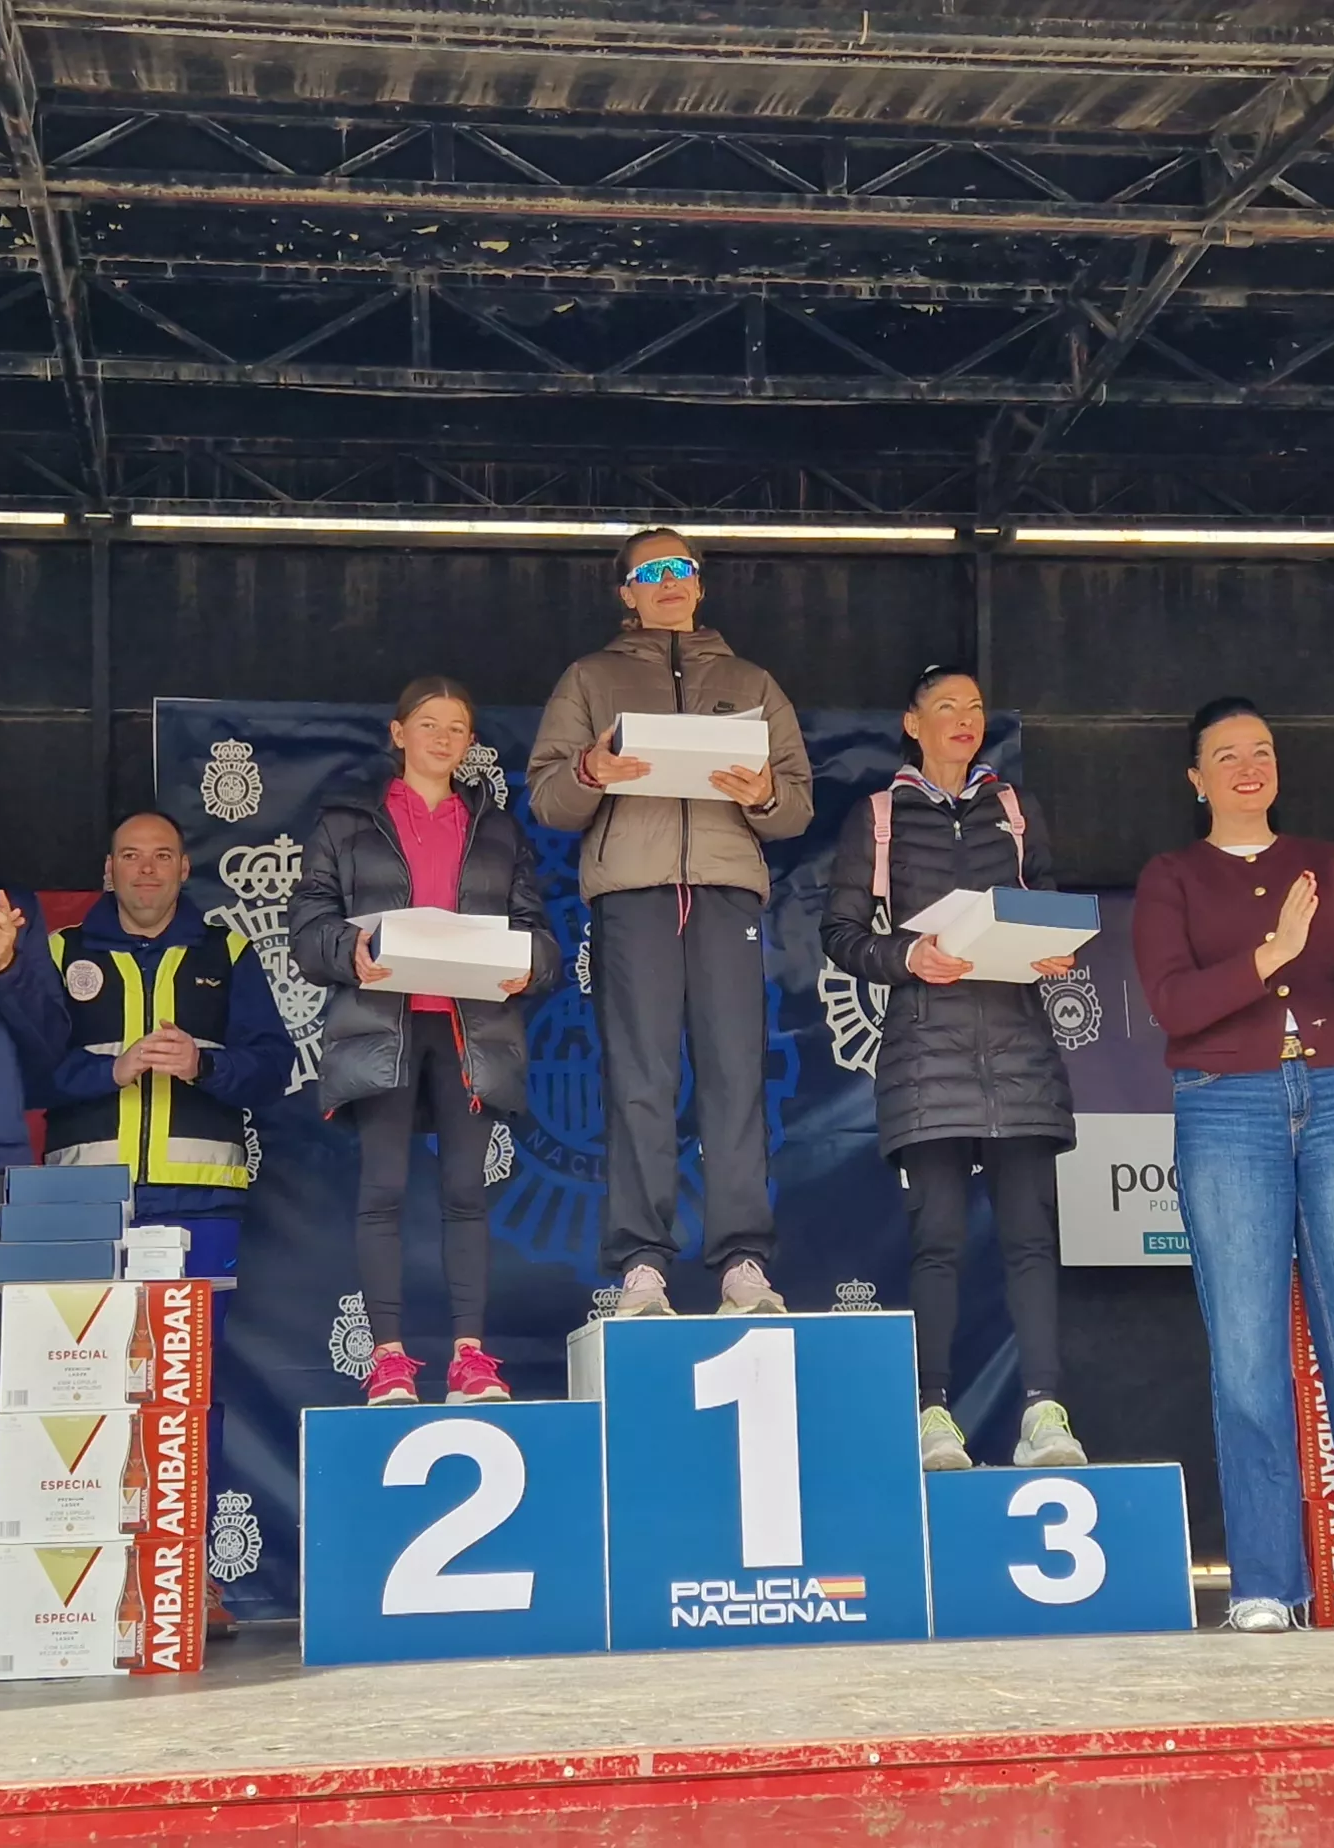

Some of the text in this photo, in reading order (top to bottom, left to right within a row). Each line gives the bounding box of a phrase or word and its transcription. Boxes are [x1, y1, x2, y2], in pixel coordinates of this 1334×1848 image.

[253, 933, 290, 952] POLI
[1149, 1199, 1180, 1212] POD
[47, 1350, 108, 1361] ESPECIAL
[163, 1283, 192, 1406] AMBAR
[693, 1327, 803, 1569] 1
[40, 1479, 102, 1491] ESPECIAL
[157, 1410, 187, 1536] AMBAR
[382, 1418, 535, 1615] 2
[1007, 1477, 1106, 1604] 3
[670, 1577, 828, 1604] POLICIA
[34, 1612, 97, 1624] ESPECIAL
[152, 1541, 183, 1670] AMBAR
[670, 1600, 867, 1628] NACIONAL
